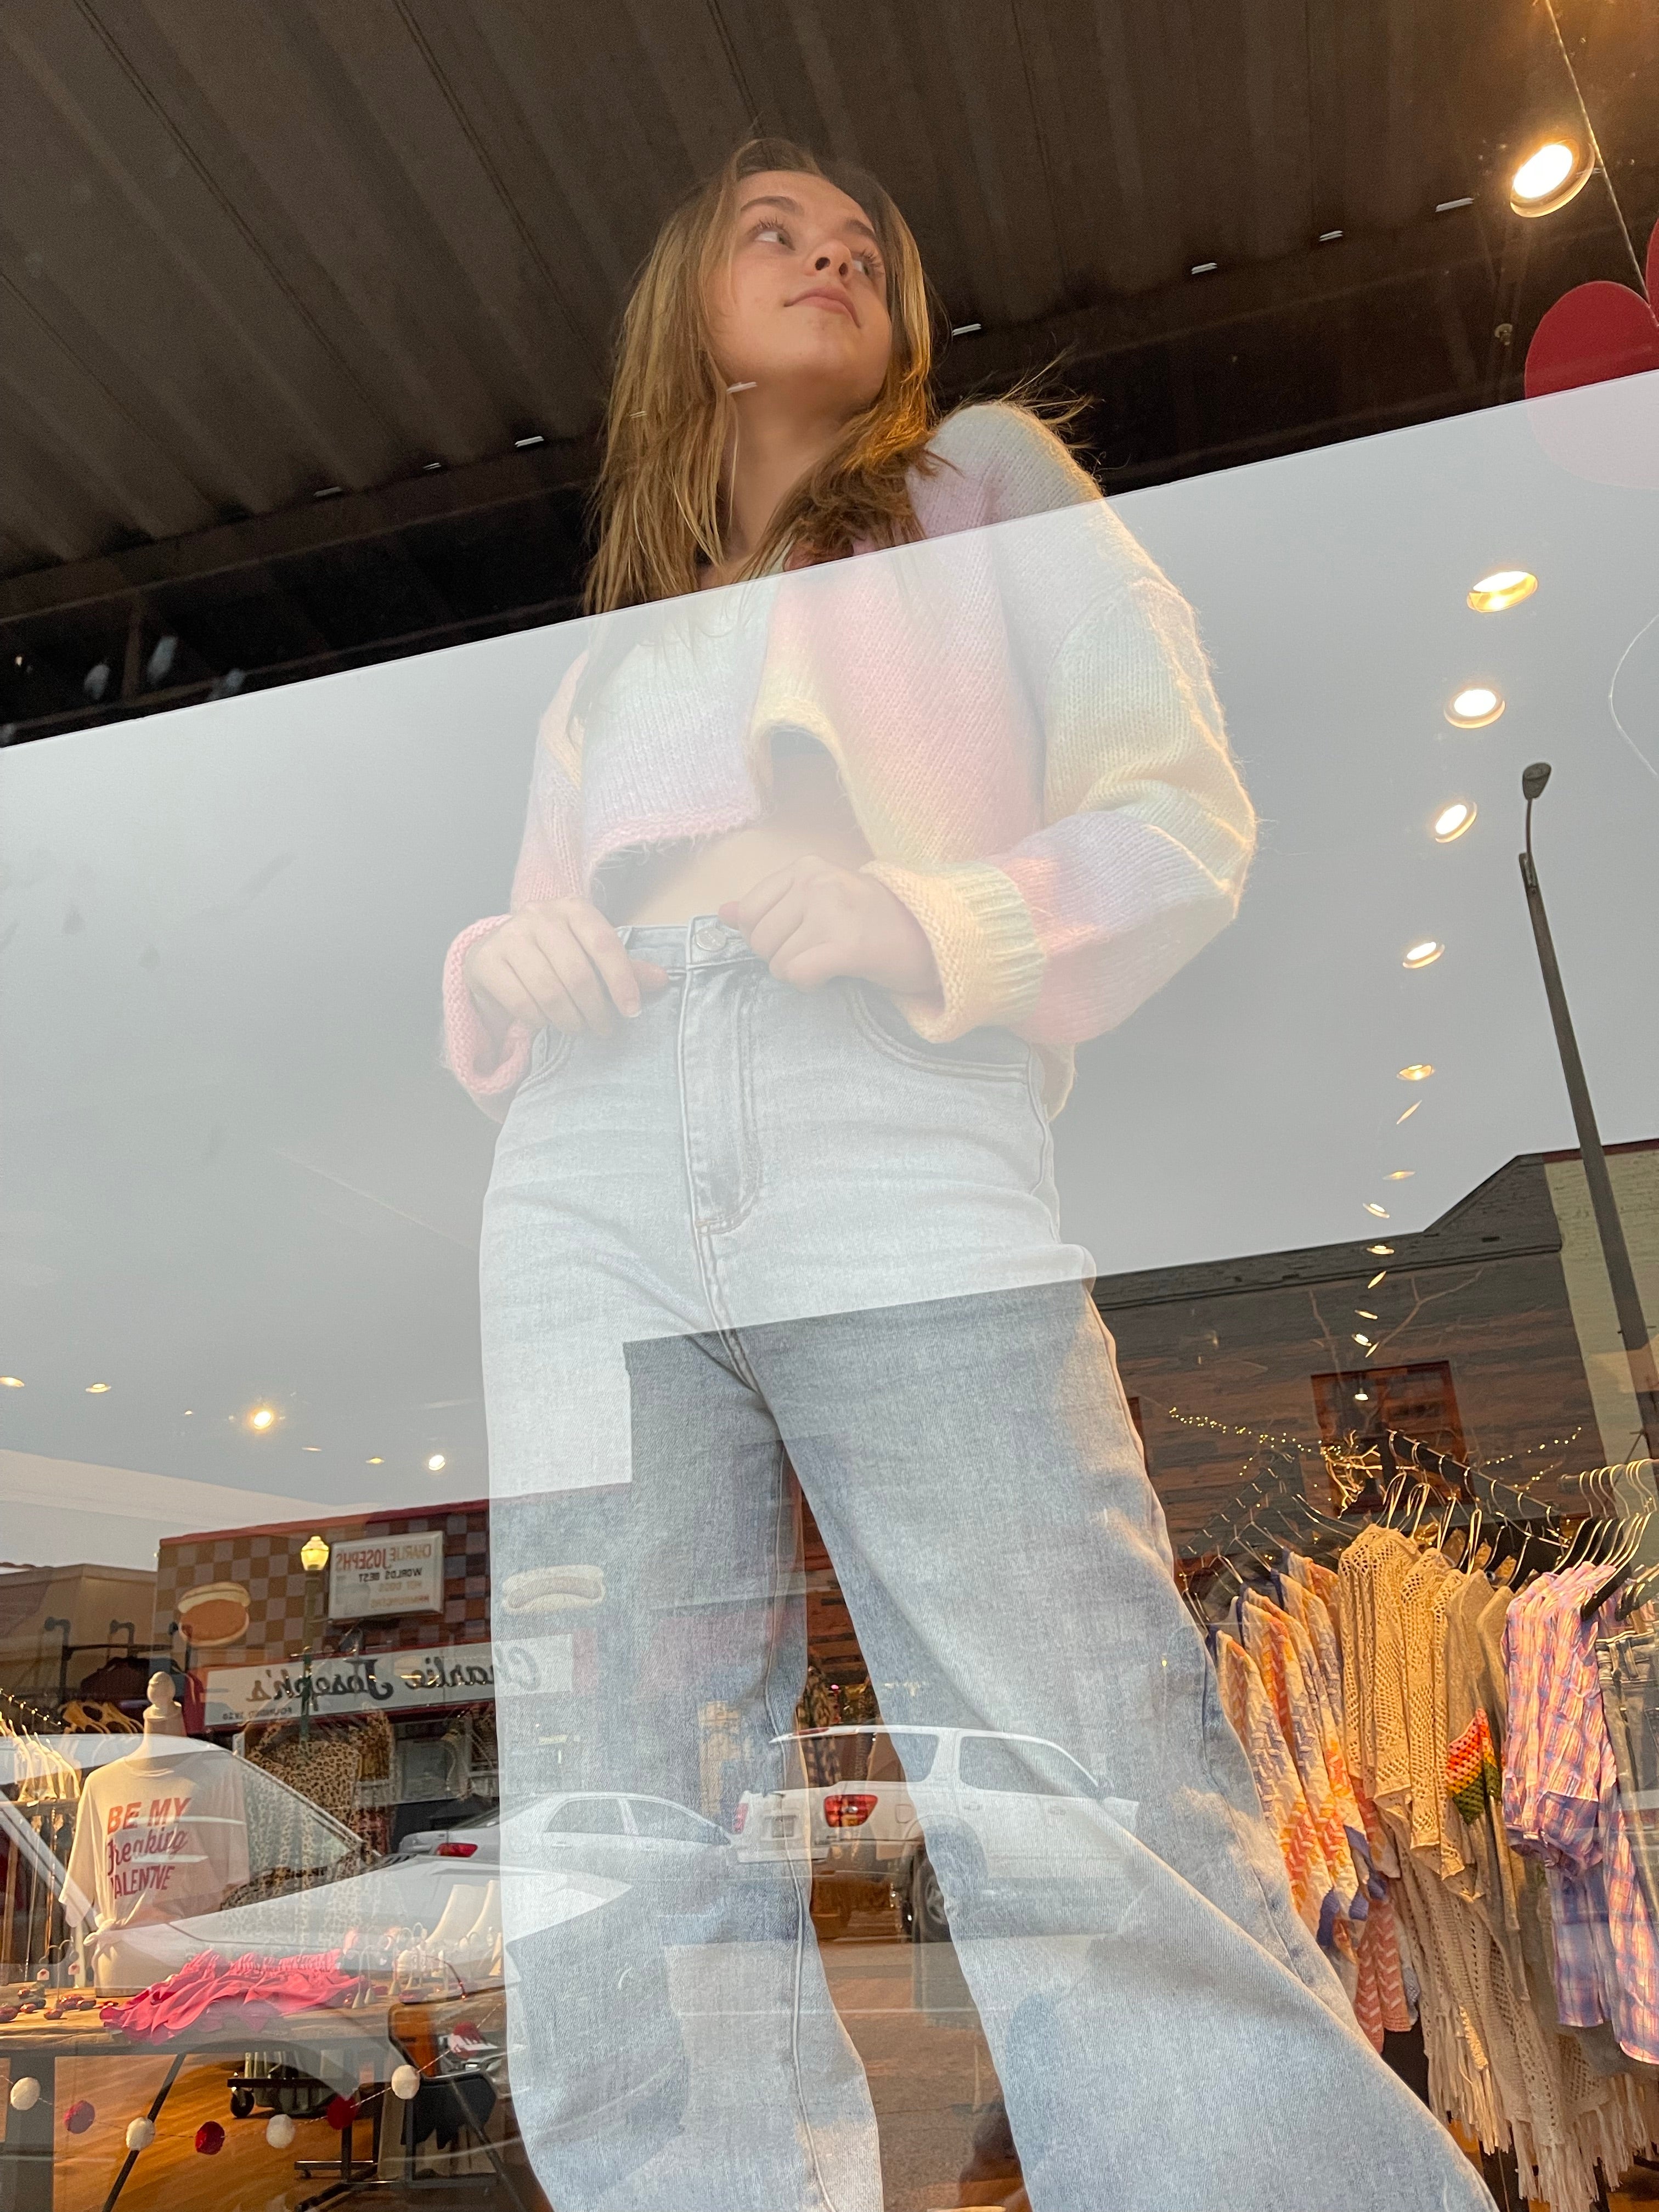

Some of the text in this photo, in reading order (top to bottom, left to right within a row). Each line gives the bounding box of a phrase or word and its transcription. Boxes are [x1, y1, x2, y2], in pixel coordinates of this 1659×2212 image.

[107, 1797, 191, 1835] BE MY
[110, 1864, 176, 1899] ALENTNE
